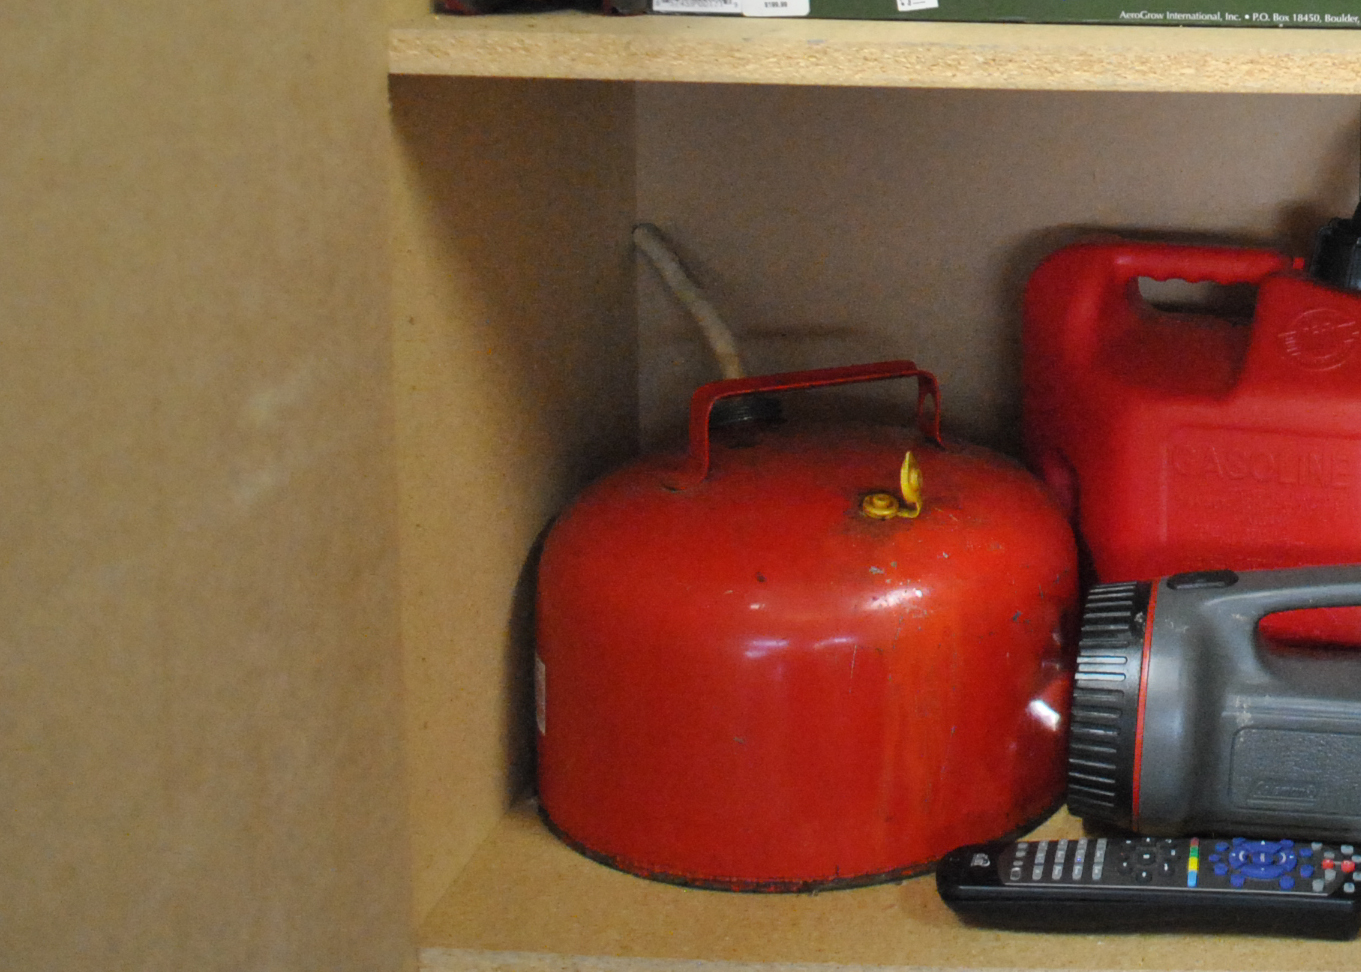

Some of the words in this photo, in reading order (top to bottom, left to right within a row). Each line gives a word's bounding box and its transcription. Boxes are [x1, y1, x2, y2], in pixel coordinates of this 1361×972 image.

[1119, 10, 1164, 20] AeroGrow
[1166, 11, 1223, 22] International,
[1225, 12, 1242, 21] Inc.
[1252, 12, 1270, 22] P.O.
[1273, 13, 1290, 22] Box
[1292, 13, 1322, 24] 18450,
[1324, 13, 1360, 24] Boulder,
